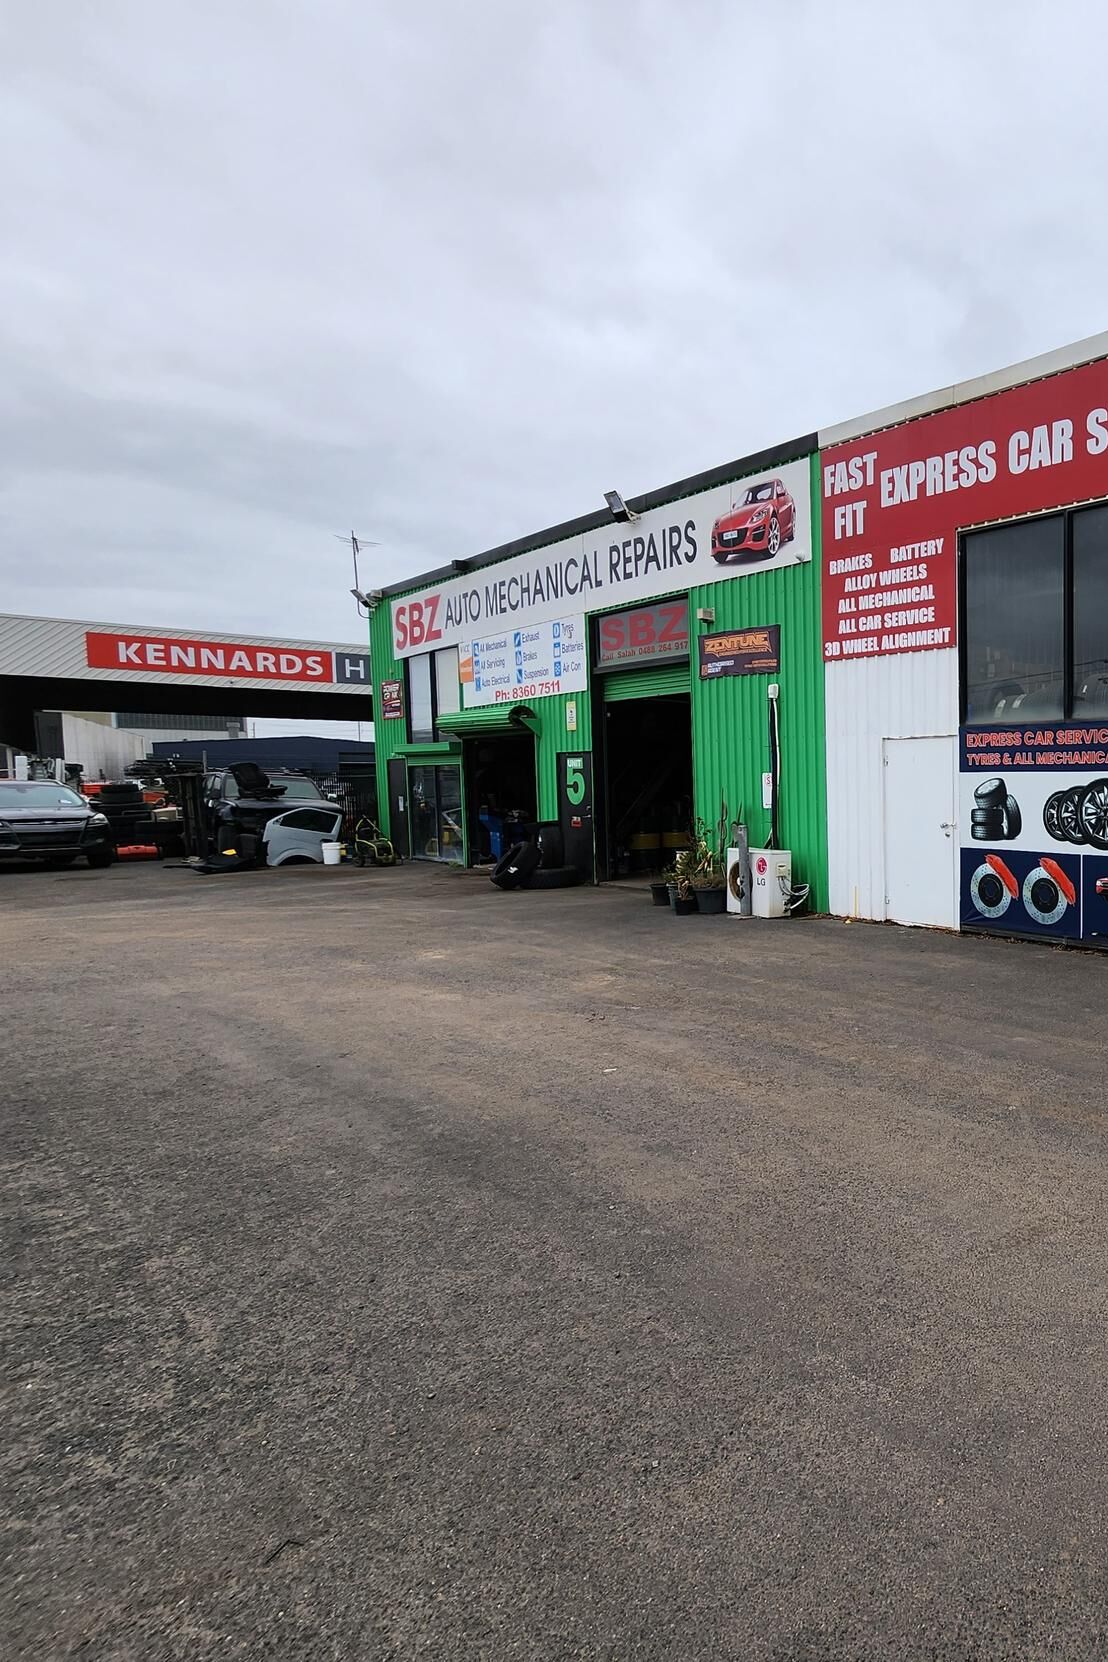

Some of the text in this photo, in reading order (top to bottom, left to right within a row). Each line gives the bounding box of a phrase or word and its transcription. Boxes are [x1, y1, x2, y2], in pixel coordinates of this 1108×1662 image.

[880, 440, 997, 508] EXPRESS
[1008, 416, 1074, 475] CAR
[824, 451, 877, 498] FAST
[834, 500, 867, 540] FIT
[829, 538, 944, 575] BRAKES BATTERY
[395, 519, 698, 651] SBZ AUTO MECHANICAL REPAIRS
[844, 563, 927, 592] ALLOY WHEELS
[838, 584, 935, 614] ALL MECHANICAL
[562, 622, 574, 636] Tyres
[602, 604, 688, 651] SBZ
[838, 606, 935, 634] ALL CAR SERVICE
[486, 638, 507, 651] Mechanical
[522, 631, 540, 644] Exhaust
[562, 641, 584, 655] Batteries
[674, 641, 688, 650] 917
[704, 631, 771, 655] ZENTUNE
[824, 627, 951, 656] 3D WHEEL ALIGNMENT
[117, 641, 366, 679] KENNARDS H
[523, 651, 538, 662] Brakes
[524, 666, 549, 680] Suspension
[563, 663, 571, 673] Air
[495, 680, 561, 701] Ph: 8360 7511
[966, 732, 1022, 748] EXPRESS
[1024, 731, 1054, 745] CAR
[567, 759, 581, 768] UNIT
[966, 752, 1001, 766] TYRES
[1002, 755, 1012, 765] &
[1013, 752, 1034, 765] ALL
[566, 758, 586, 805] 5
[756, 878, 766, 886] LG
